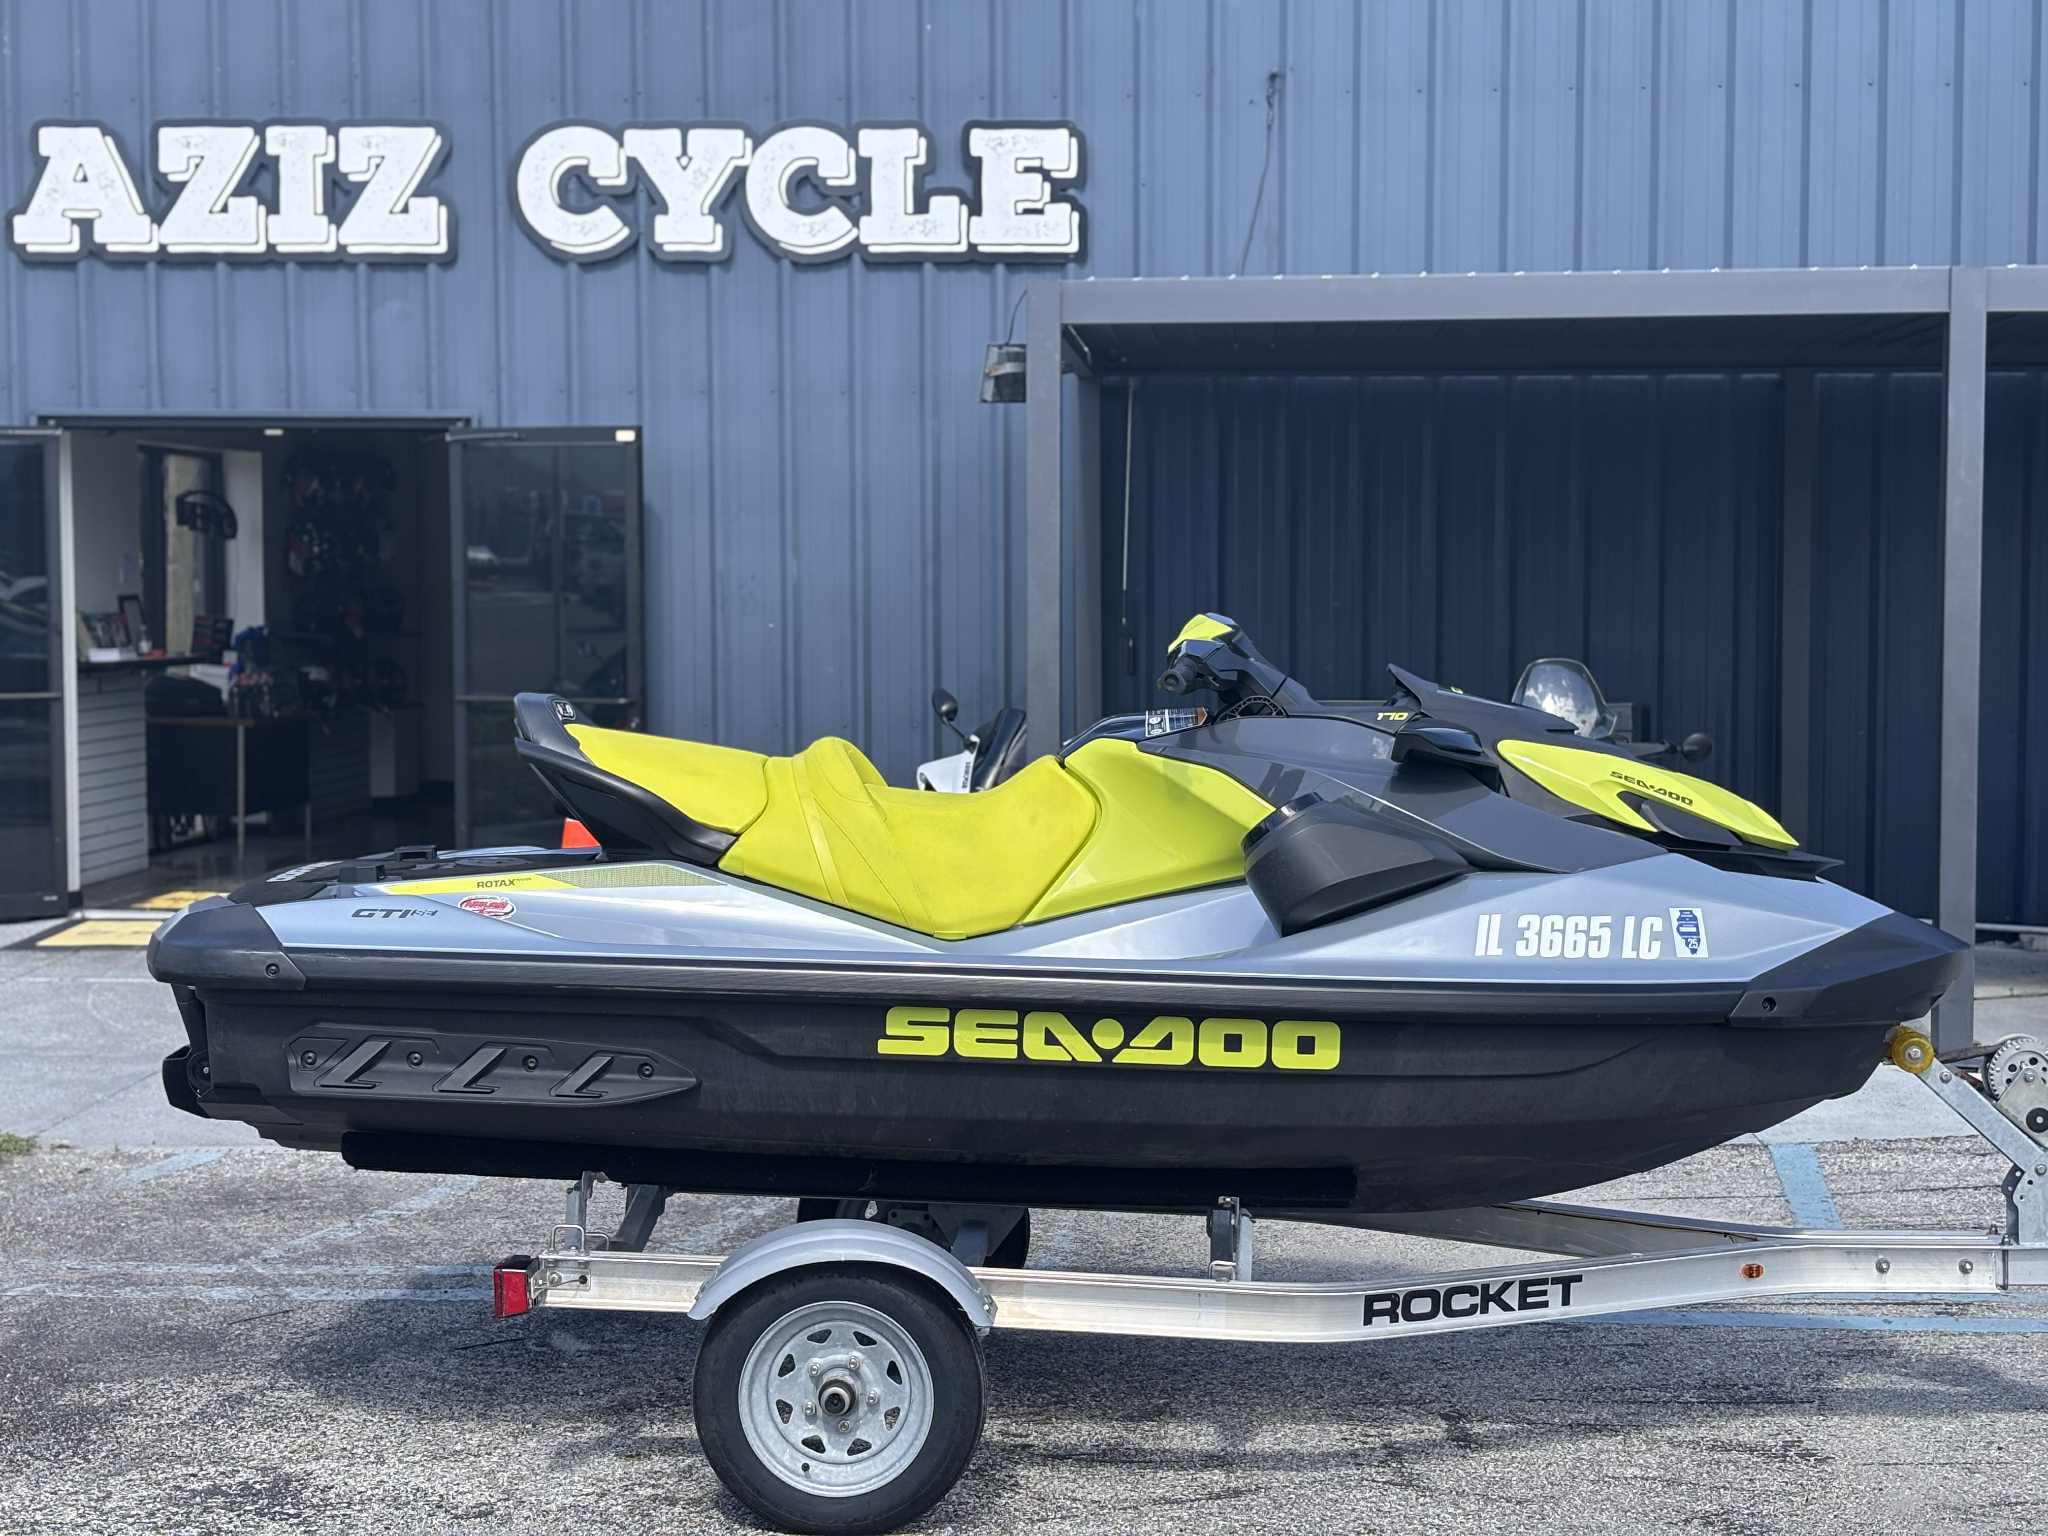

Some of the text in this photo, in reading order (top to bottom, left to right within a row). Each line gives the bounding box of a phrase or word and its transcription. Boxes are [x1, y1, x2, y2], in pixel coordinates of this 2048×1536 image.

[13, 126, 1081, 255] AZIZ CYCLE
[476, 879, 516, 889] ROTAX
[352, 908, 412, 919] GTI
[1474, 914, 1504, 957] IL
[1515, 914, 1613, 959] 3665
[1621, 915, 1664, 960] LC
[1687, 938, 1699, 949] 25
[1363, 1274, 1583, 1327] ROCKET
